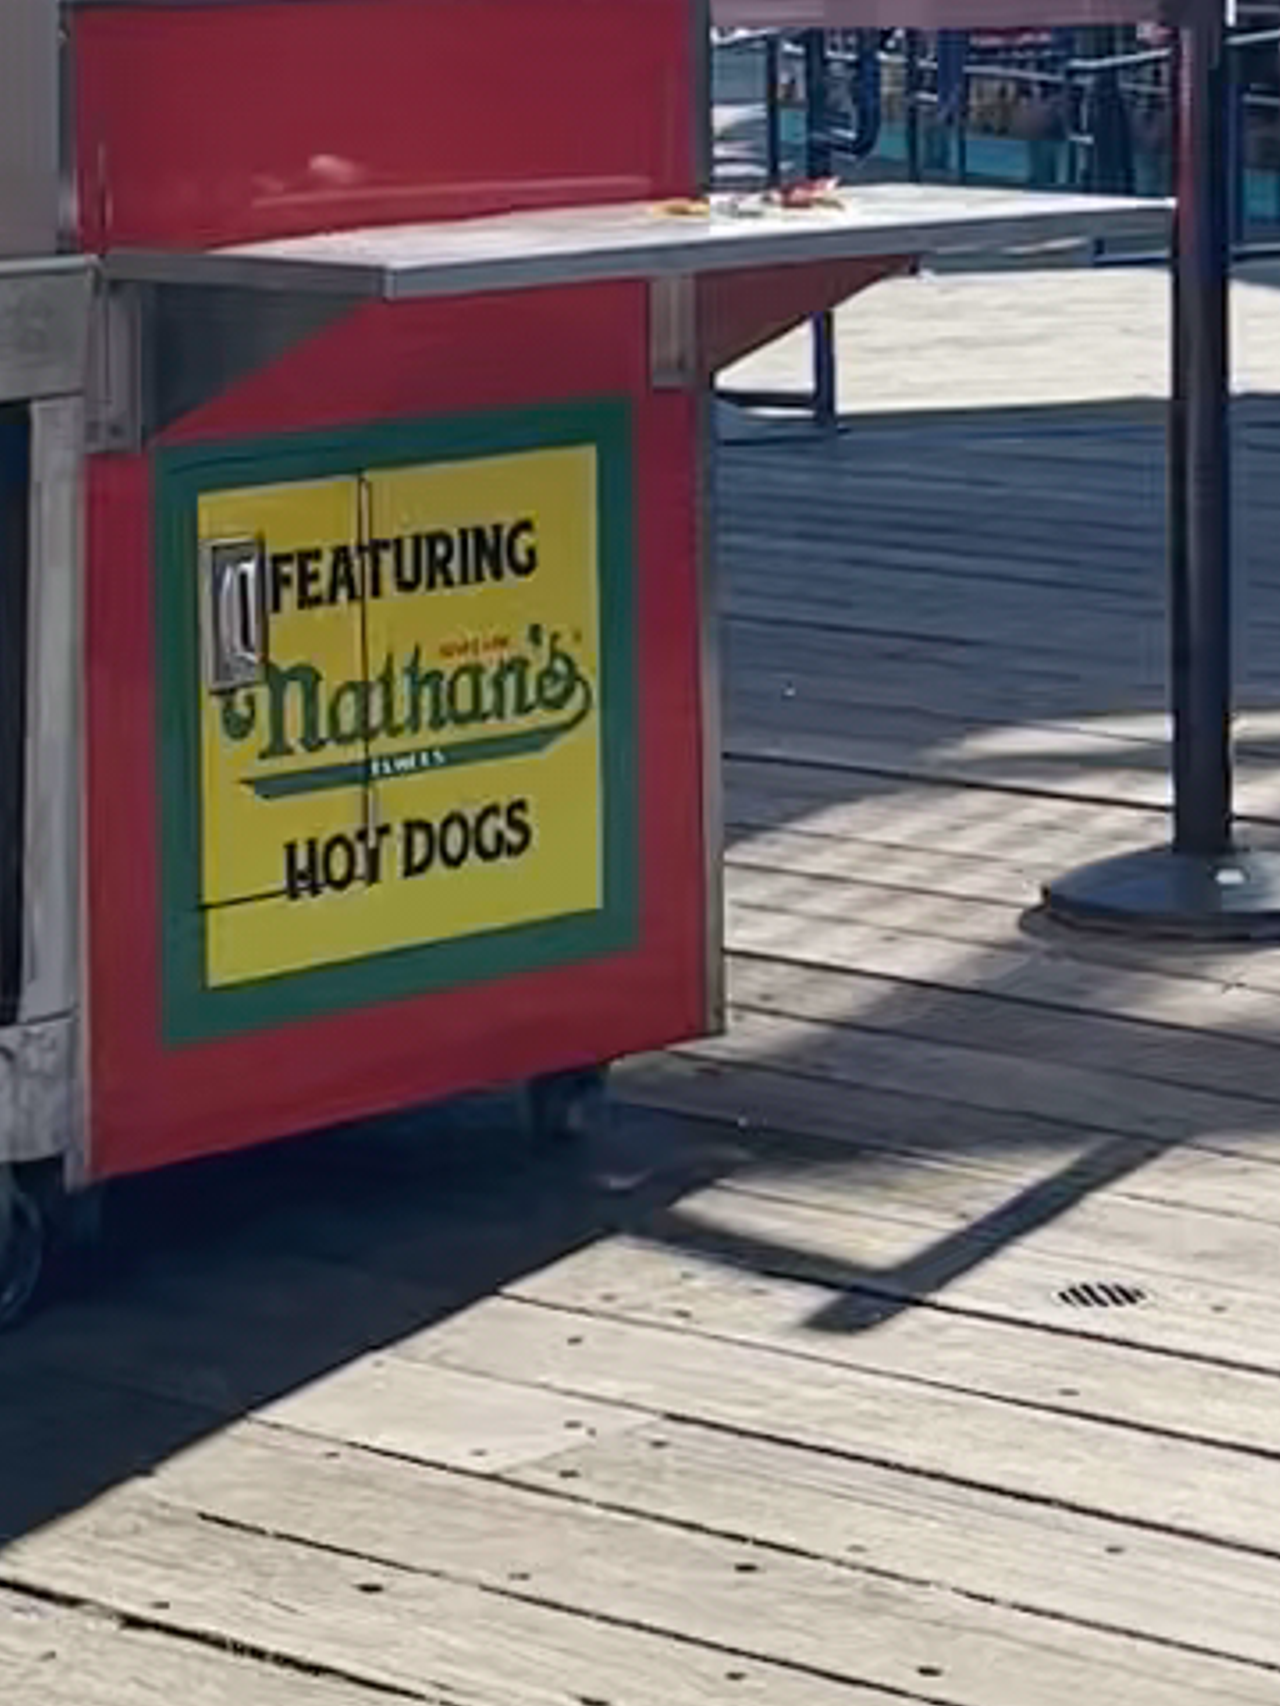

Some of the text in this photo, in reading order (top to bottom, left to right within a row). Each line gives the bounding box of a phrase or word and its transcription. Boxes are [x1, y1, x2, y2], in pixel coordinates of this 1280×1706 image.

[269, 519, 538, 614] FEATURING
[222, 623, 584, 760] Nathan's
[284, 798, 534, 901] HOT DOGS
